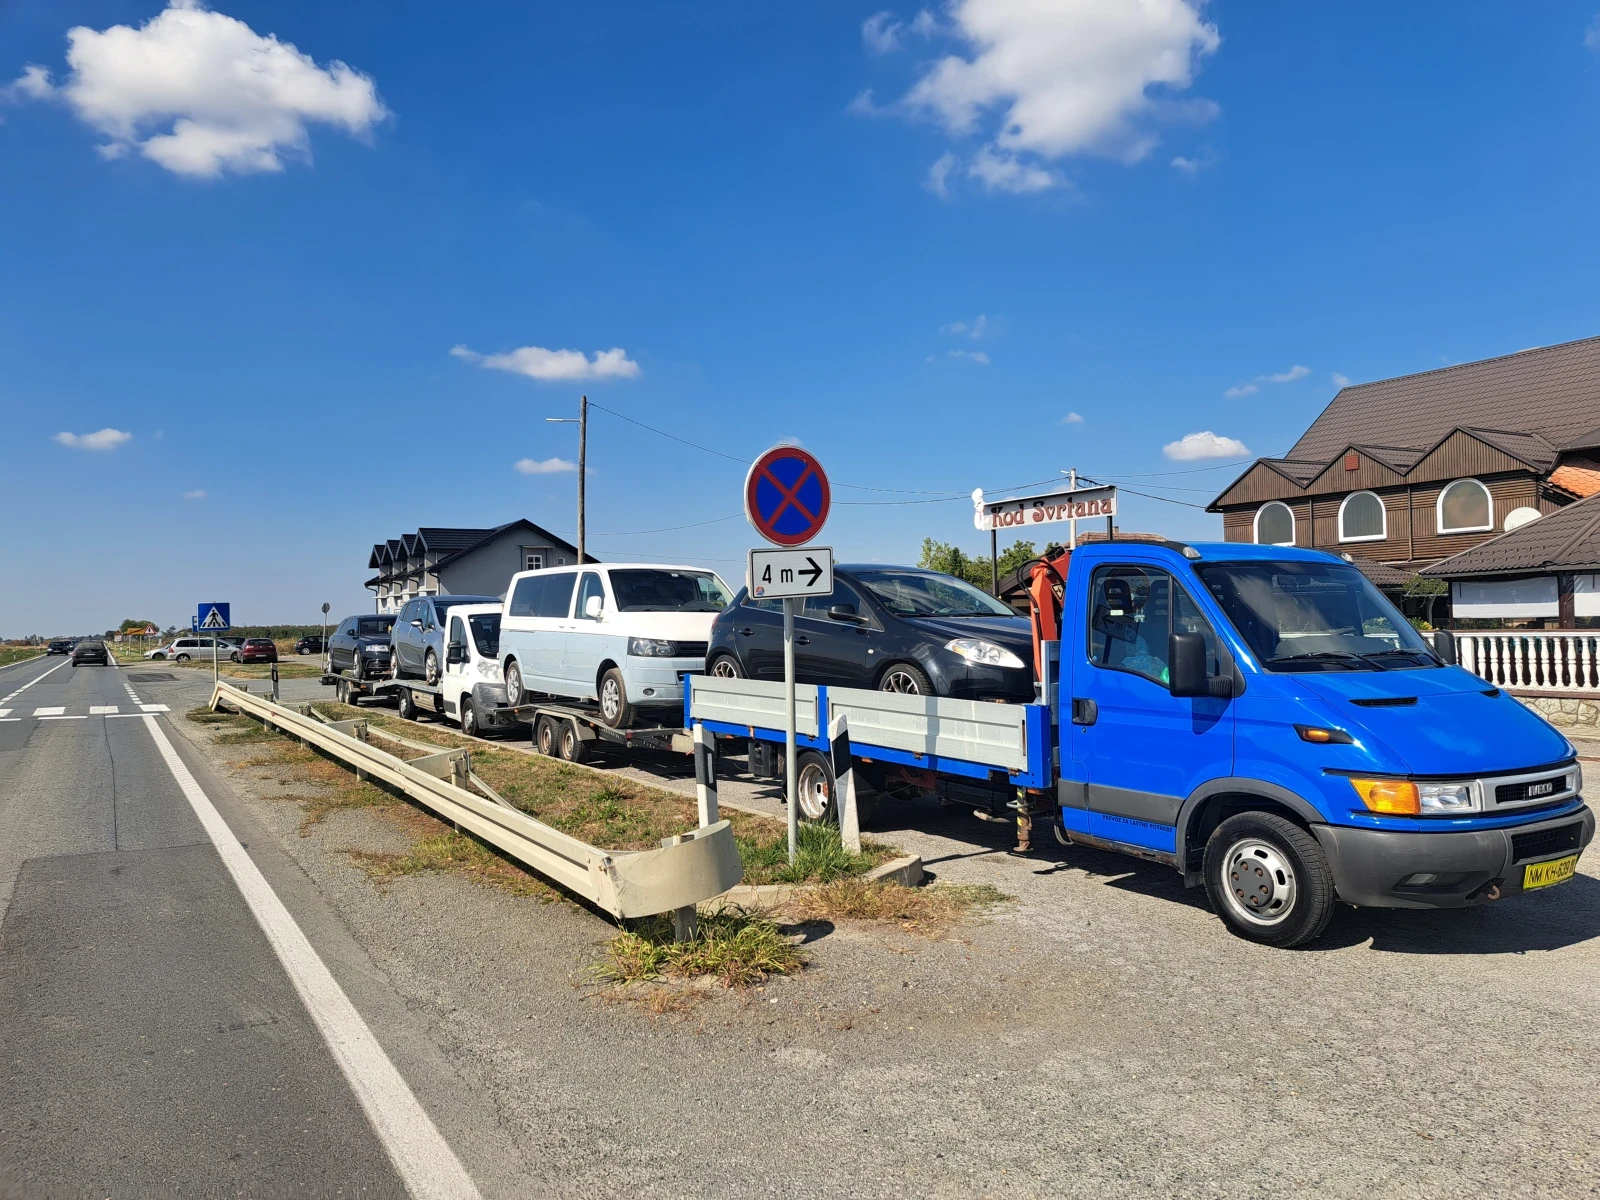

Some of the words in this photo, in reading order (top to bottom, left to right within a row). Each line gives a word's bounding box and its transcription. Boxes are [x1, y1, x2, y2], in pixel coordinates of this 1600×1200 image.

[991, 503, 1025, 527] Kod
[762, 564, 772, 584] 4
[780, 568, 793, 583] m
[1528, 782, 1552, 797] IVECO
[1102, 815, 1121, 823] PREVOZ
[1528, 867, 1543, 884] NM
